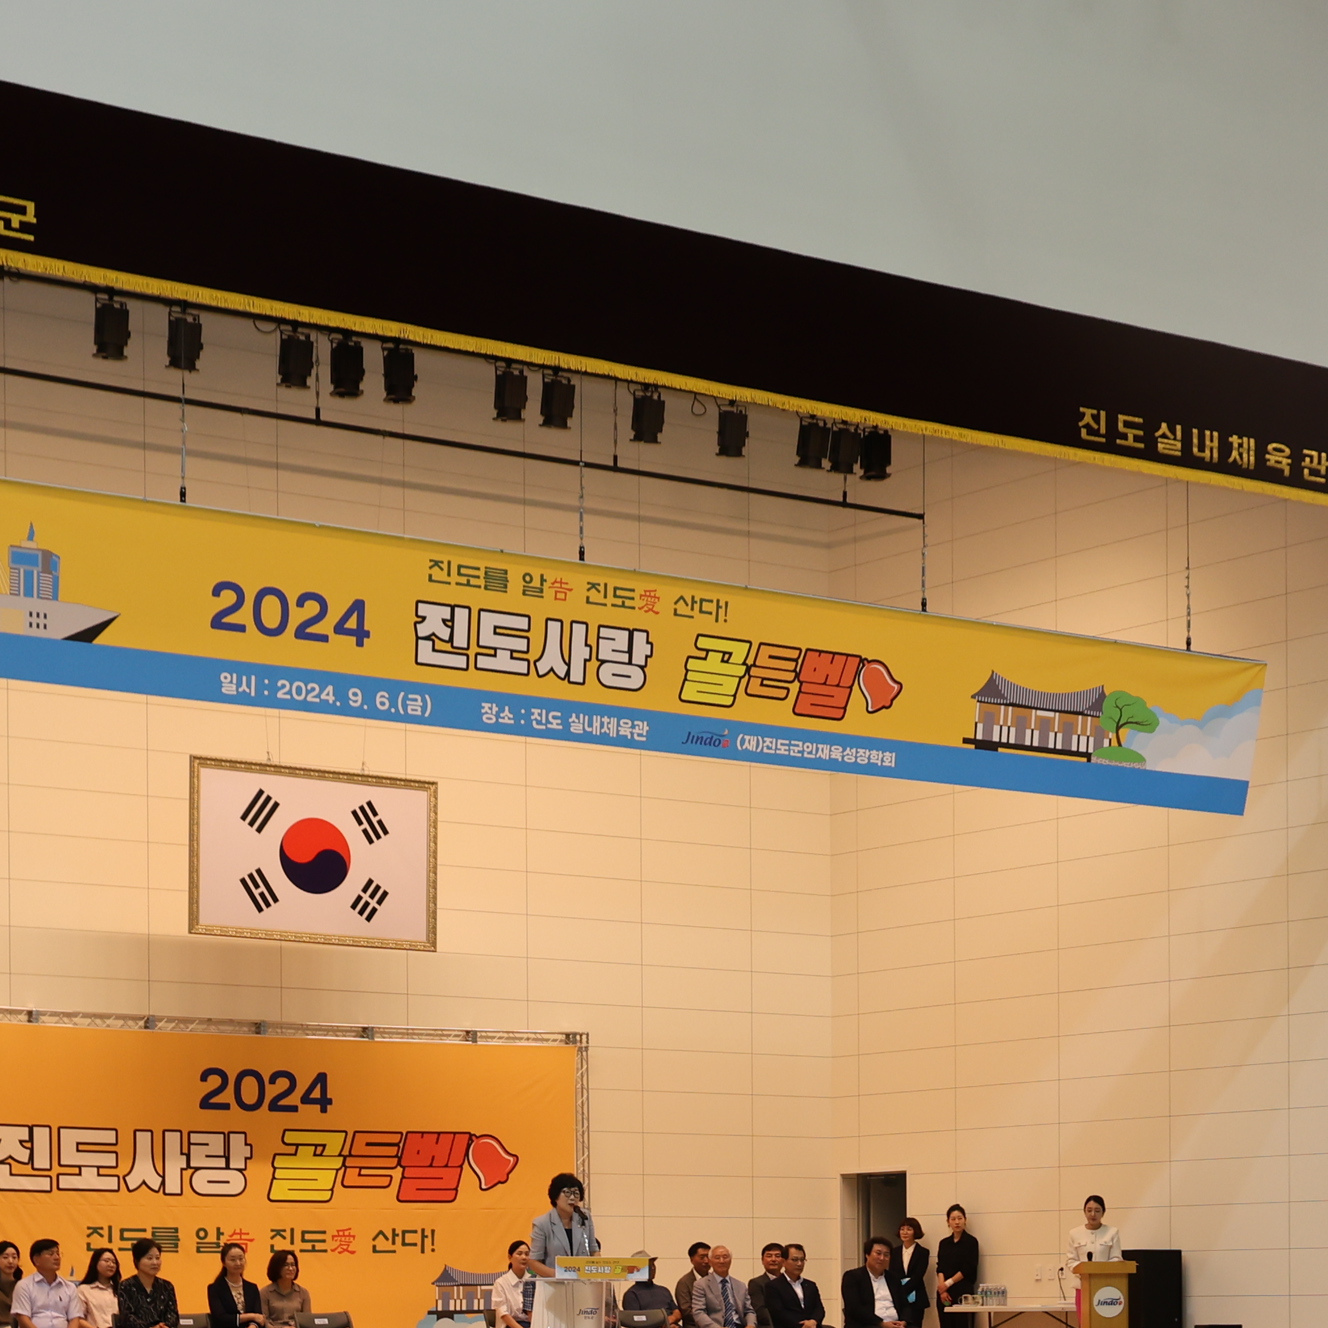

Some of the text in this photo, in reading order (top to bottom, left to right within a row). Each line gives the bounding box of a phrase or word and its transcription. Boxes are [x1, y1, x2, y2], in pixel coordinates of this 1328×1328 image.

[208, 580, 371, 649] 2024
[428, 559, 509, 593] 진도를
[585, 581, 661, 615] 진도愛
[673, 594, 729, 623] 산다!
[413, 599, 864, 721] 진도사랑 골든벨
[219, 672, 256, 697] 일시
[277, 679, 340, 706] 2024.
[481, 702, 514, 725] 장소
[530, 707, 563, 730] 진도
[568, 711, 649, 741] 실내체육관
[198, 1066, 333, 1113] 2024
[267, 1129, 471, 1203] 골든벨
[85, 1224, 180, 1254] 진도를
[270, 1226, 357, 1254] 진도愛
[372, 1227, 436, 1254] 산다!
